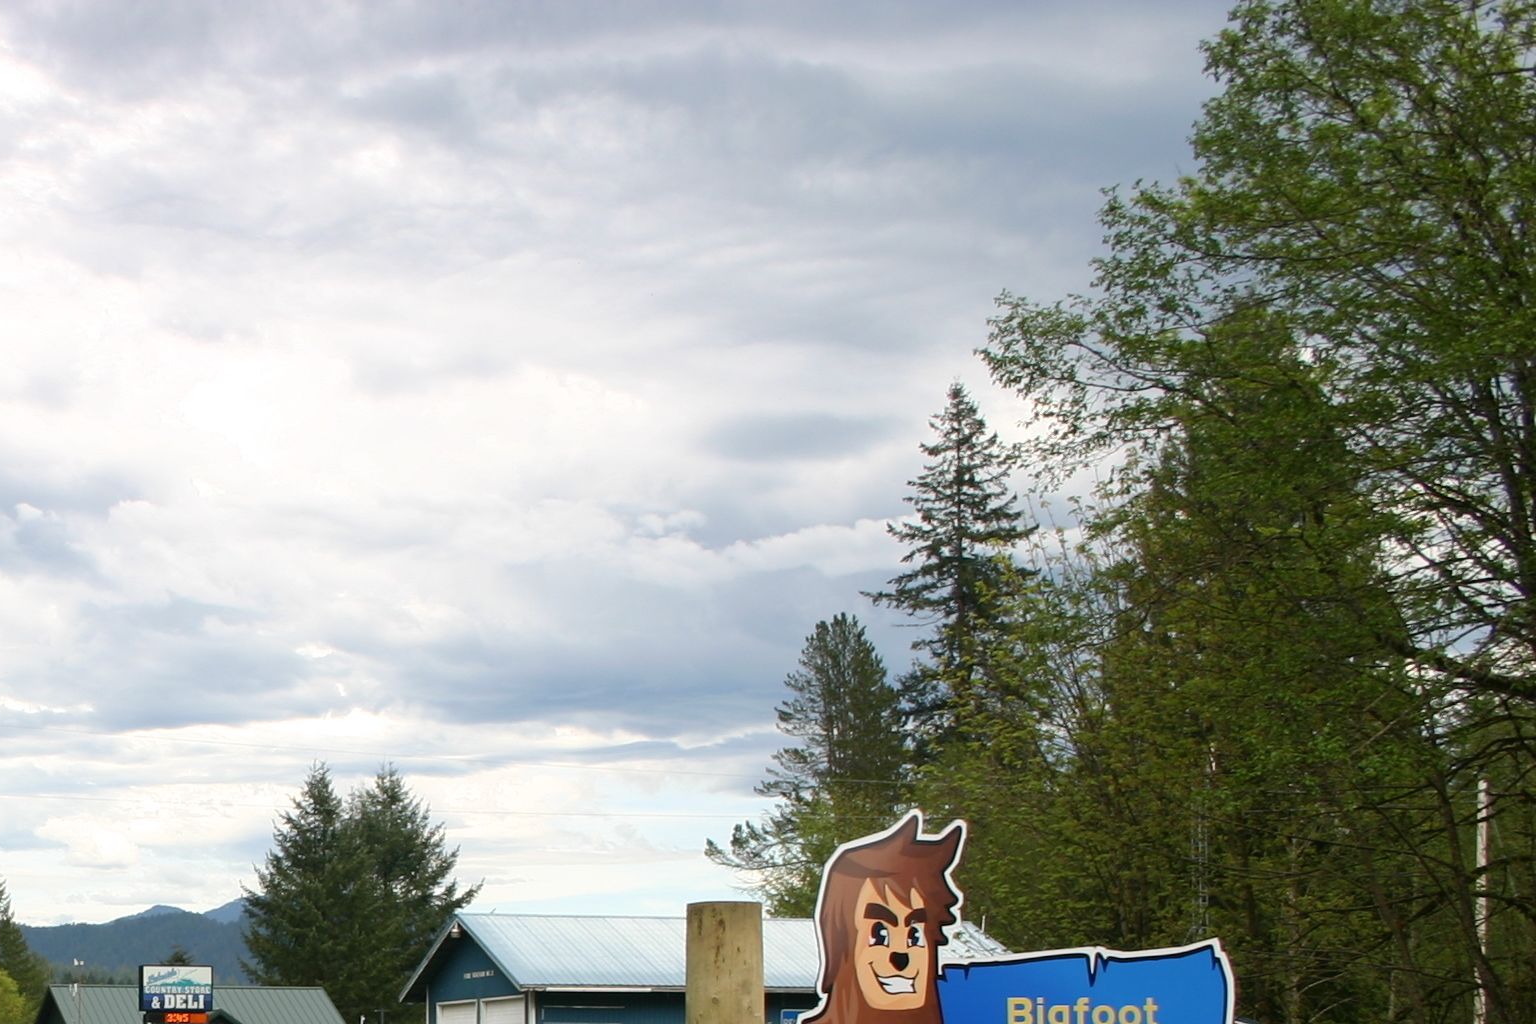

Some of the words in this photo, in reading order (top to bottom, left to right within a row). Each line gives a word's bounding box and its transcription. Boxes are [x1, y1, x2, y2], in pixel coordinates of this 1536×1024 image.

[184, 985, 211, 994] STORE
[151, 996, 161, 1009] &
[164, 994, 205, 1010] DELI
